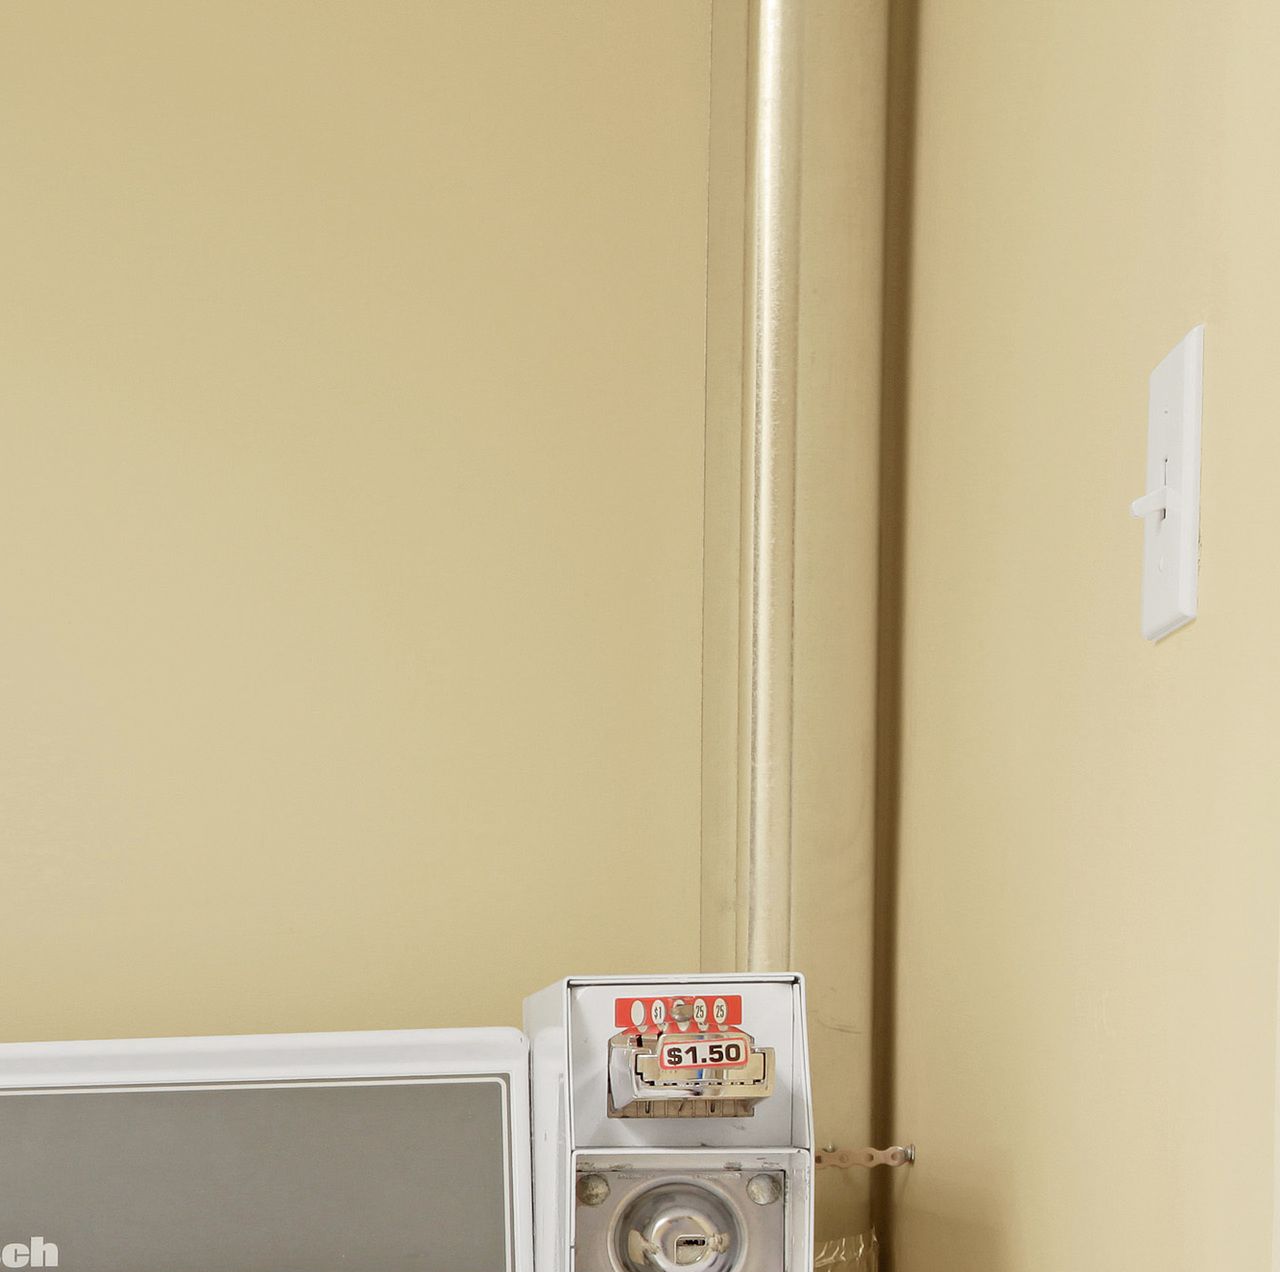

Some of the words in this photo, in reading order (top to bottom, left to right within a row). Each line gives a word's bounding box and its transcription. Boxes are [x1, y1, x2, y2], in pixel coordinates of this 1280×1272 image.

[653, 1006, 662, 1018] $1
[695, 1005, 704, 1018] 25
[715, 1005, 725, 1018] 25
[667, 1043, 741, 1066] $1.50
